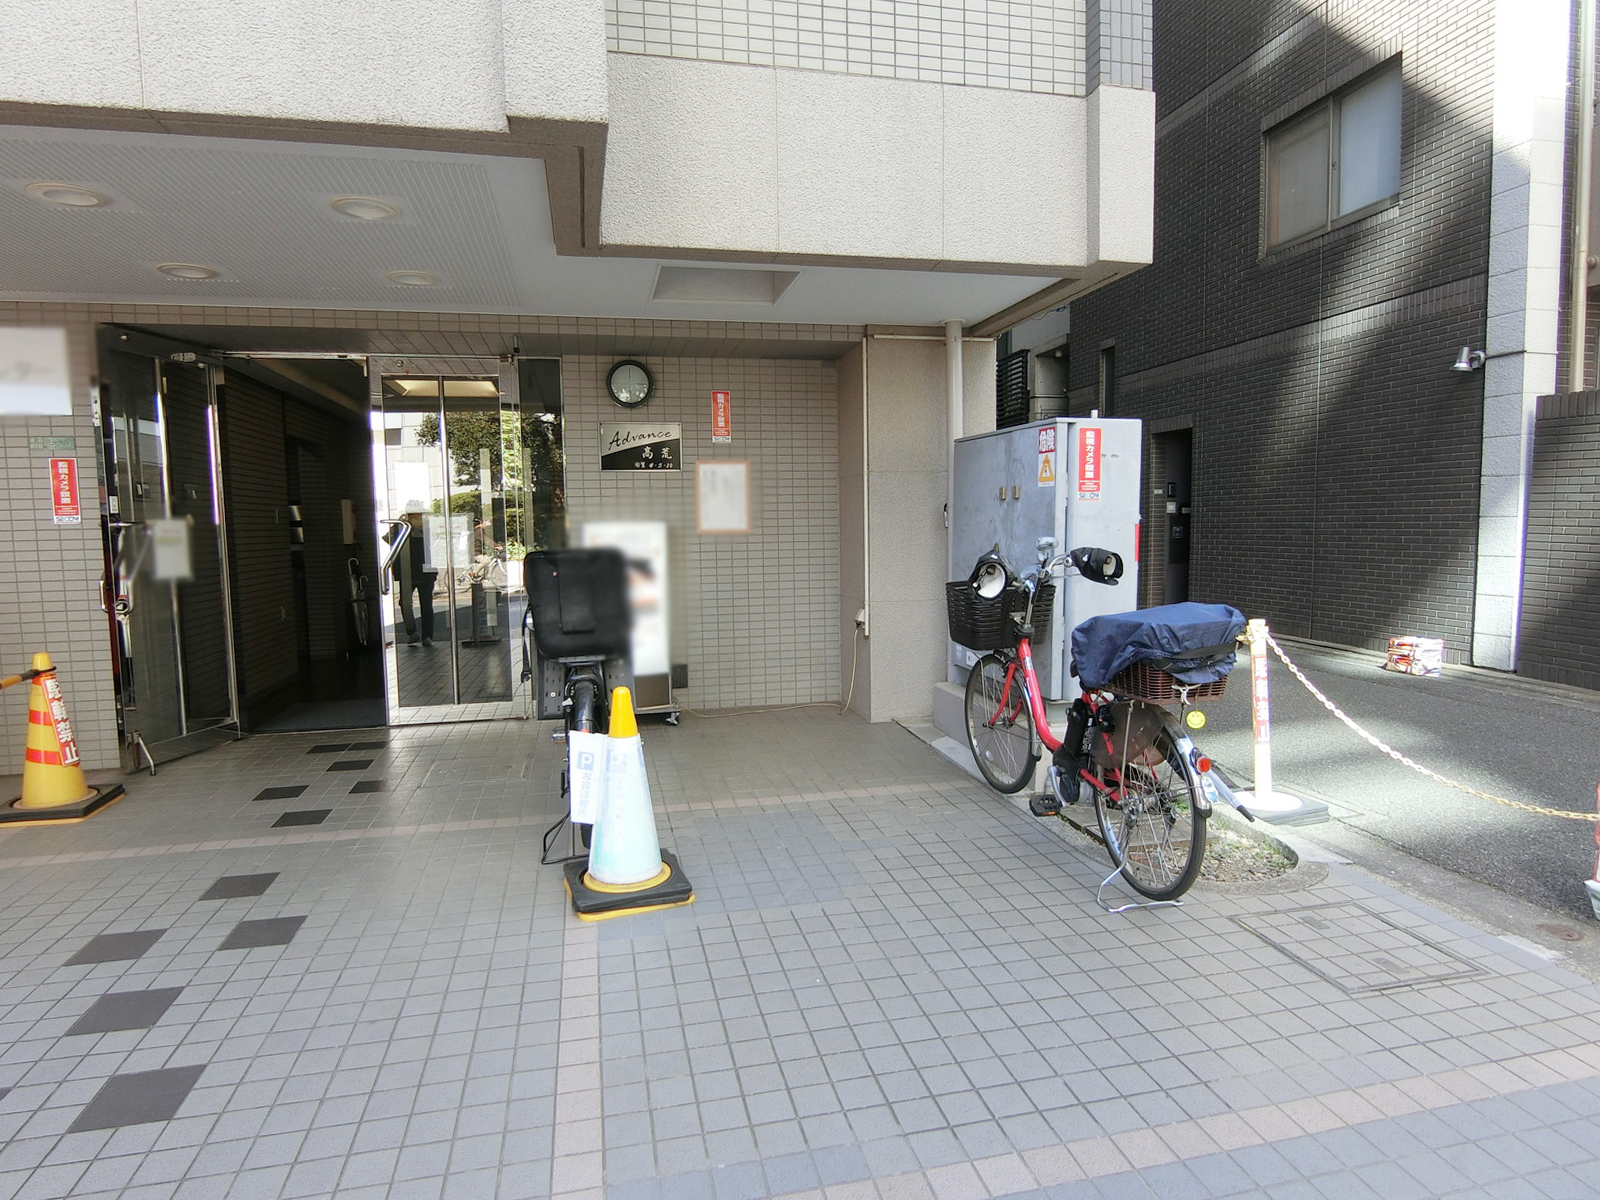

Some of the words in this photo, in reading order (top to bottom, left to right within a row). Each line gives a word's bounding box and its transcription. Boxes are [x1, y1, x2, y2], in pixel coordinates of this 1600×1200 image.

[608, 431, 672, 450] Advance
[1039, 429, 1055, 451] 危険
[1085, 431, 1095, 478] 監視カメラ設置
[57, 461, 71, 504] 監視カメラ設置
[45, 679, 80, 764] 駐輪禁止
